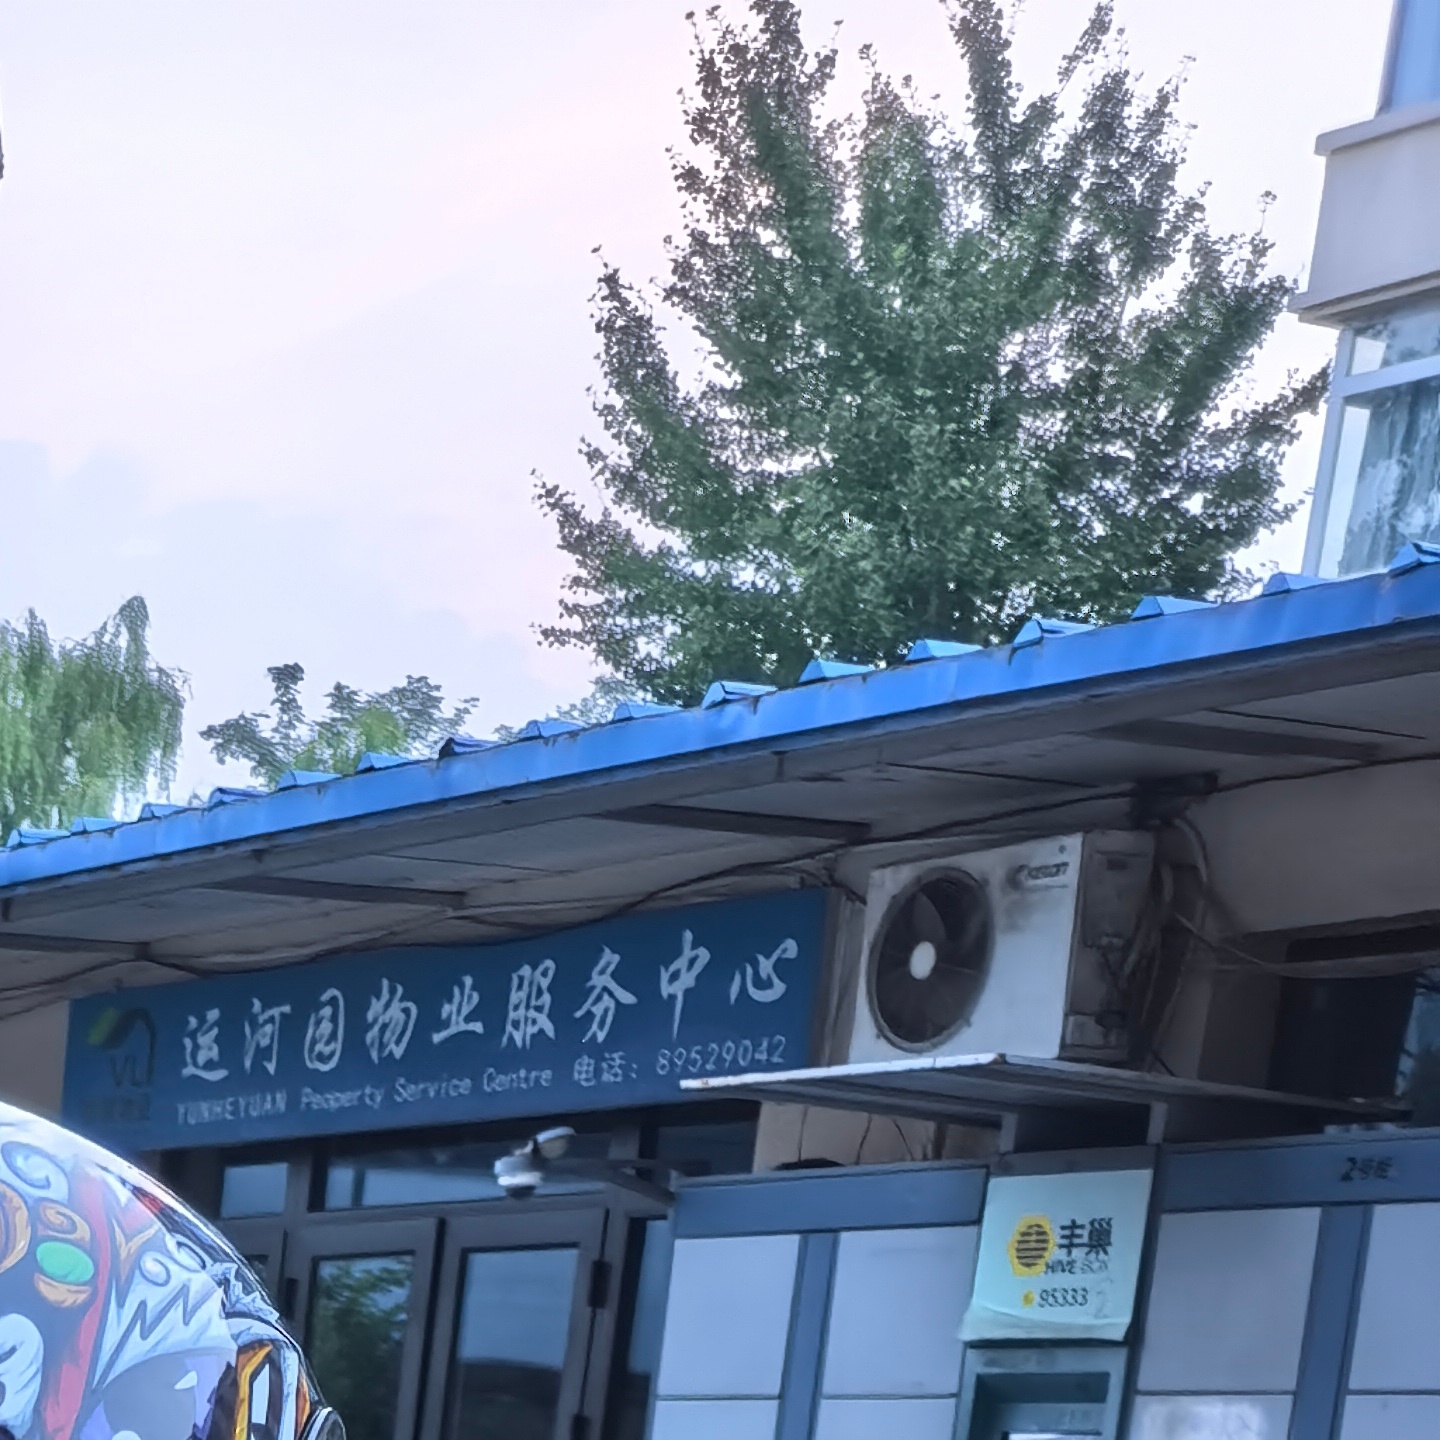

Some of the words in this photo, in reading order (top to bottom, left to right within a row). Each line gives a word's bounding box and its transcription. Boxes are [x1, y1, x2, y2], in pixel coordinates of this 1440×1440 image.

[180, 929, 799, 1082] 运河园物业服务中心
[656, 1034, 787, 1076] 89529042
[1057, 1217, 1113, 1259] 丰巢
[1038, 1287, 1089, 1308] 95333
